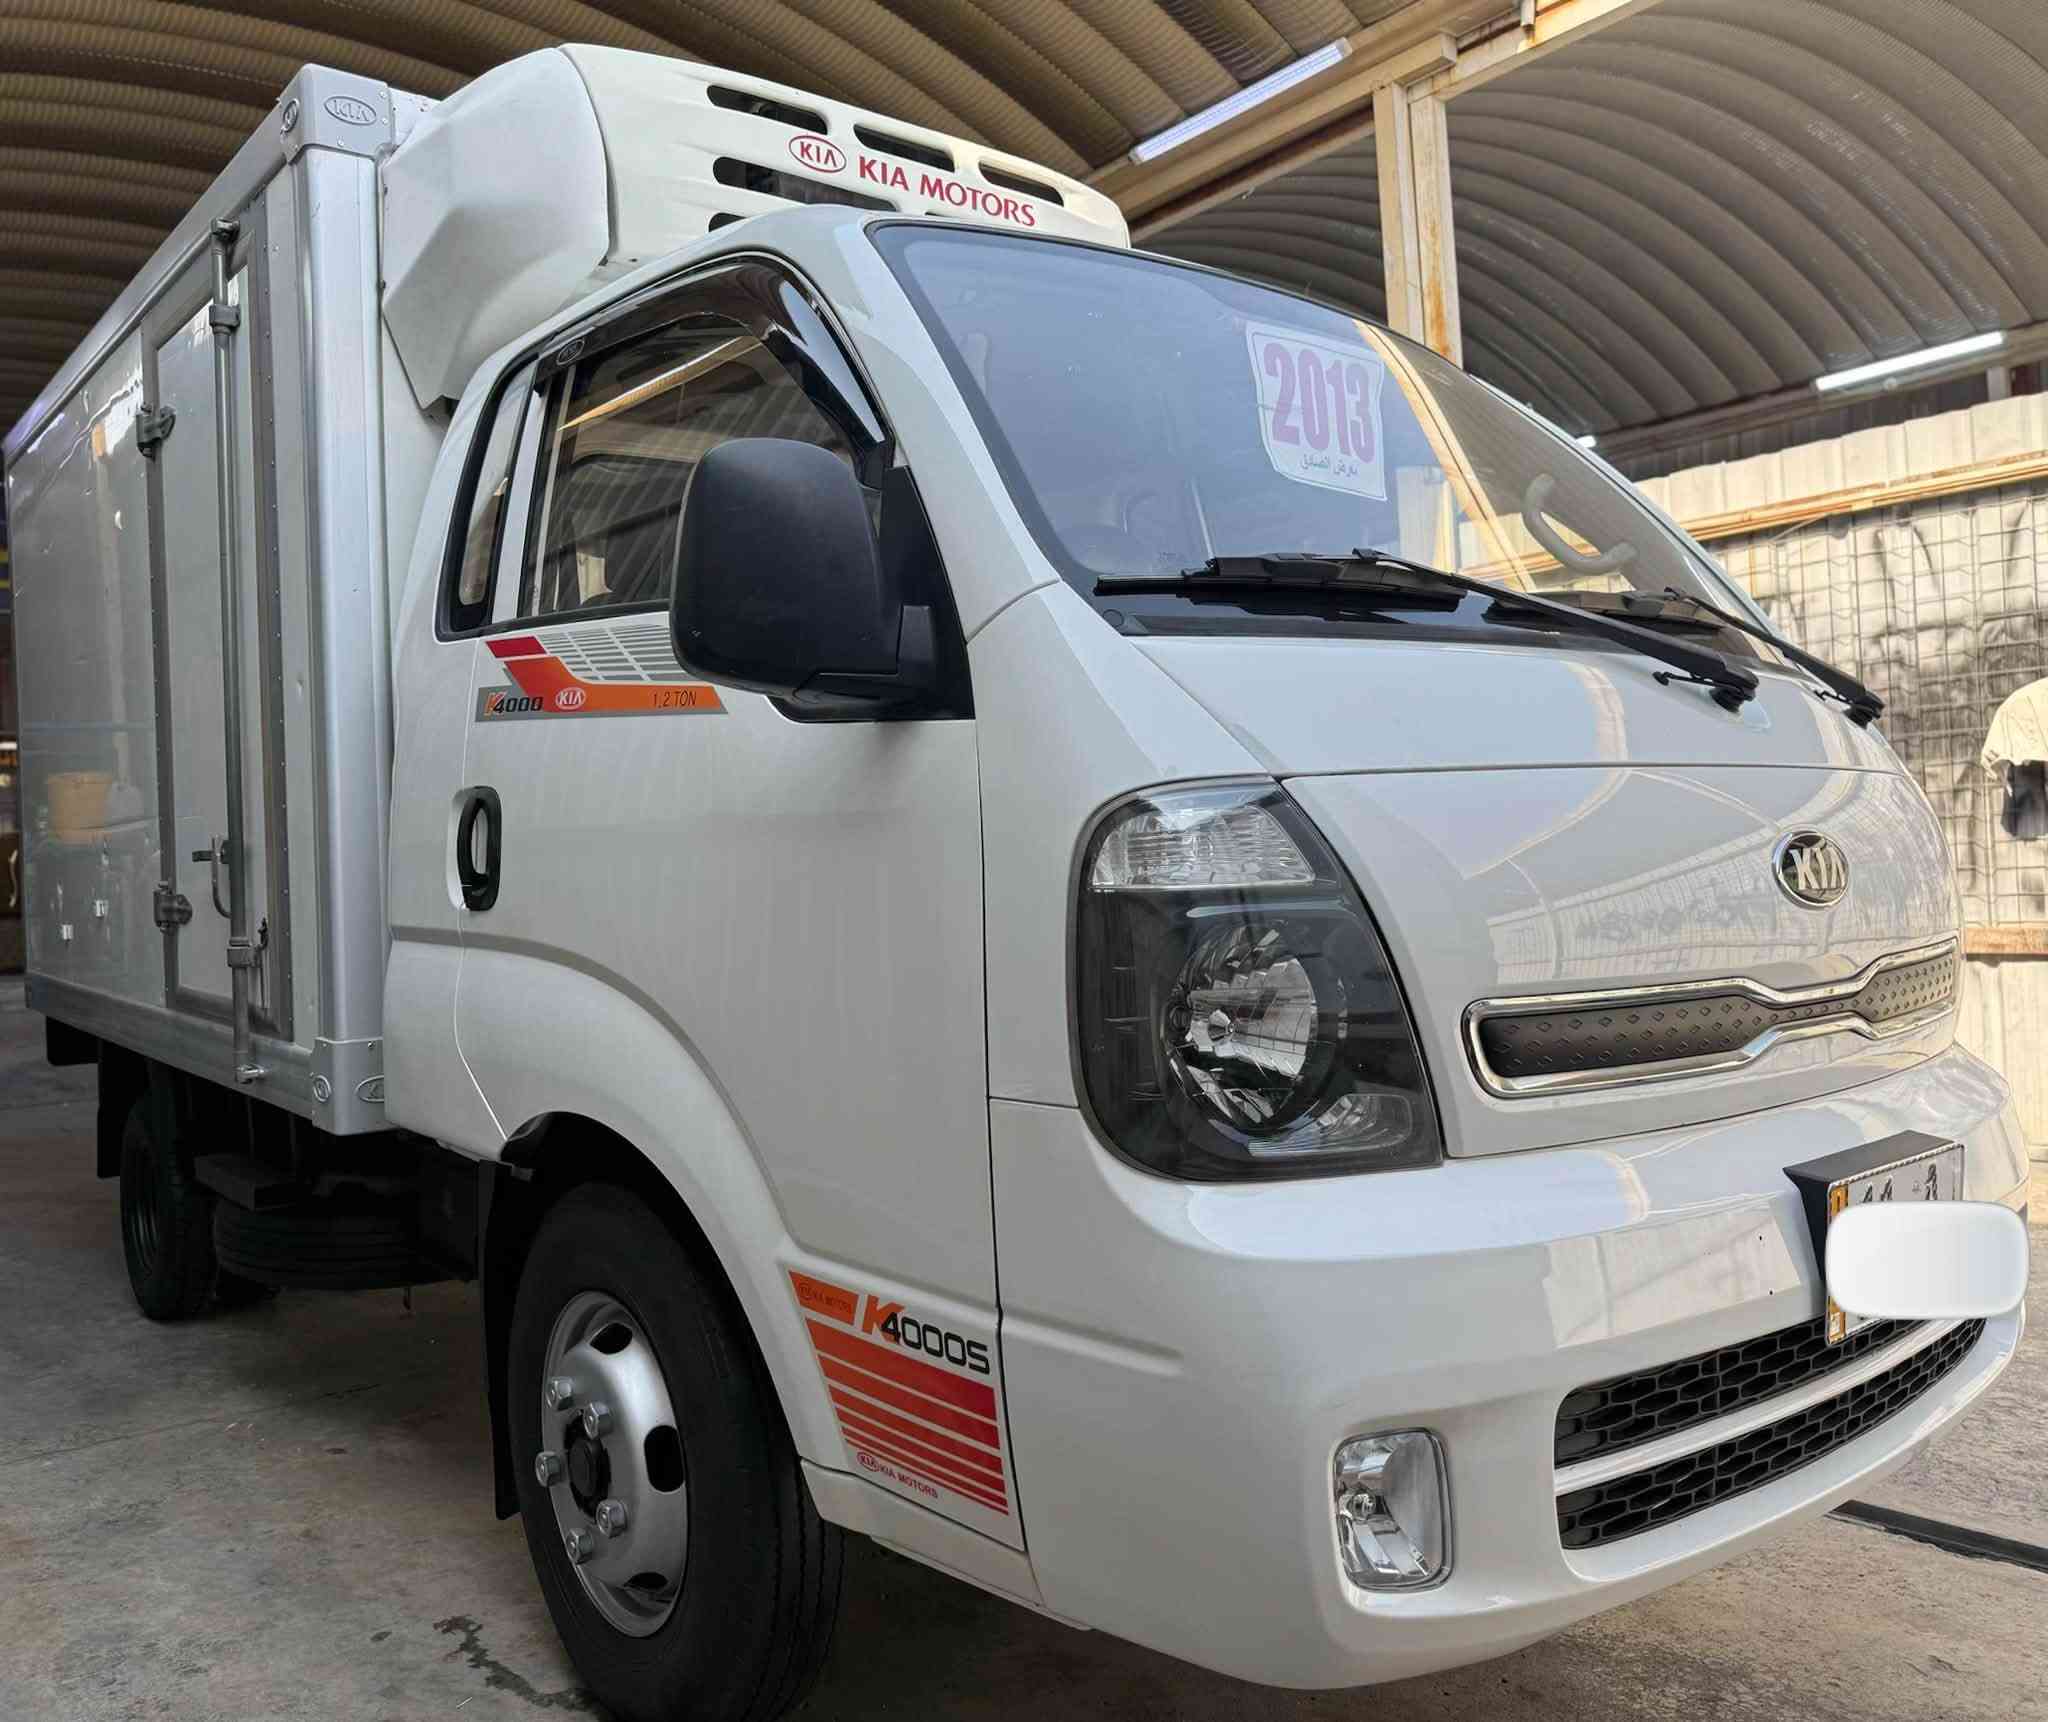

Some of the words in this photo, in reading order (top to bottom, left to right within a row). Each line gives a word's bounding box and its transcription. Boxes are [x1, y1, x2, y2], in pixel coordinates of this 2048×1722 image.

[800, 141, 837, 168] KIA
[859, 155, 910, 192] KIA
[919, 173, 1036, 227] MOTORS
[1263, 342, 1375, 463] 2013
[1788, 847, 1846, 890] KIA
[862, 1294, 990, 1375] K4000S
